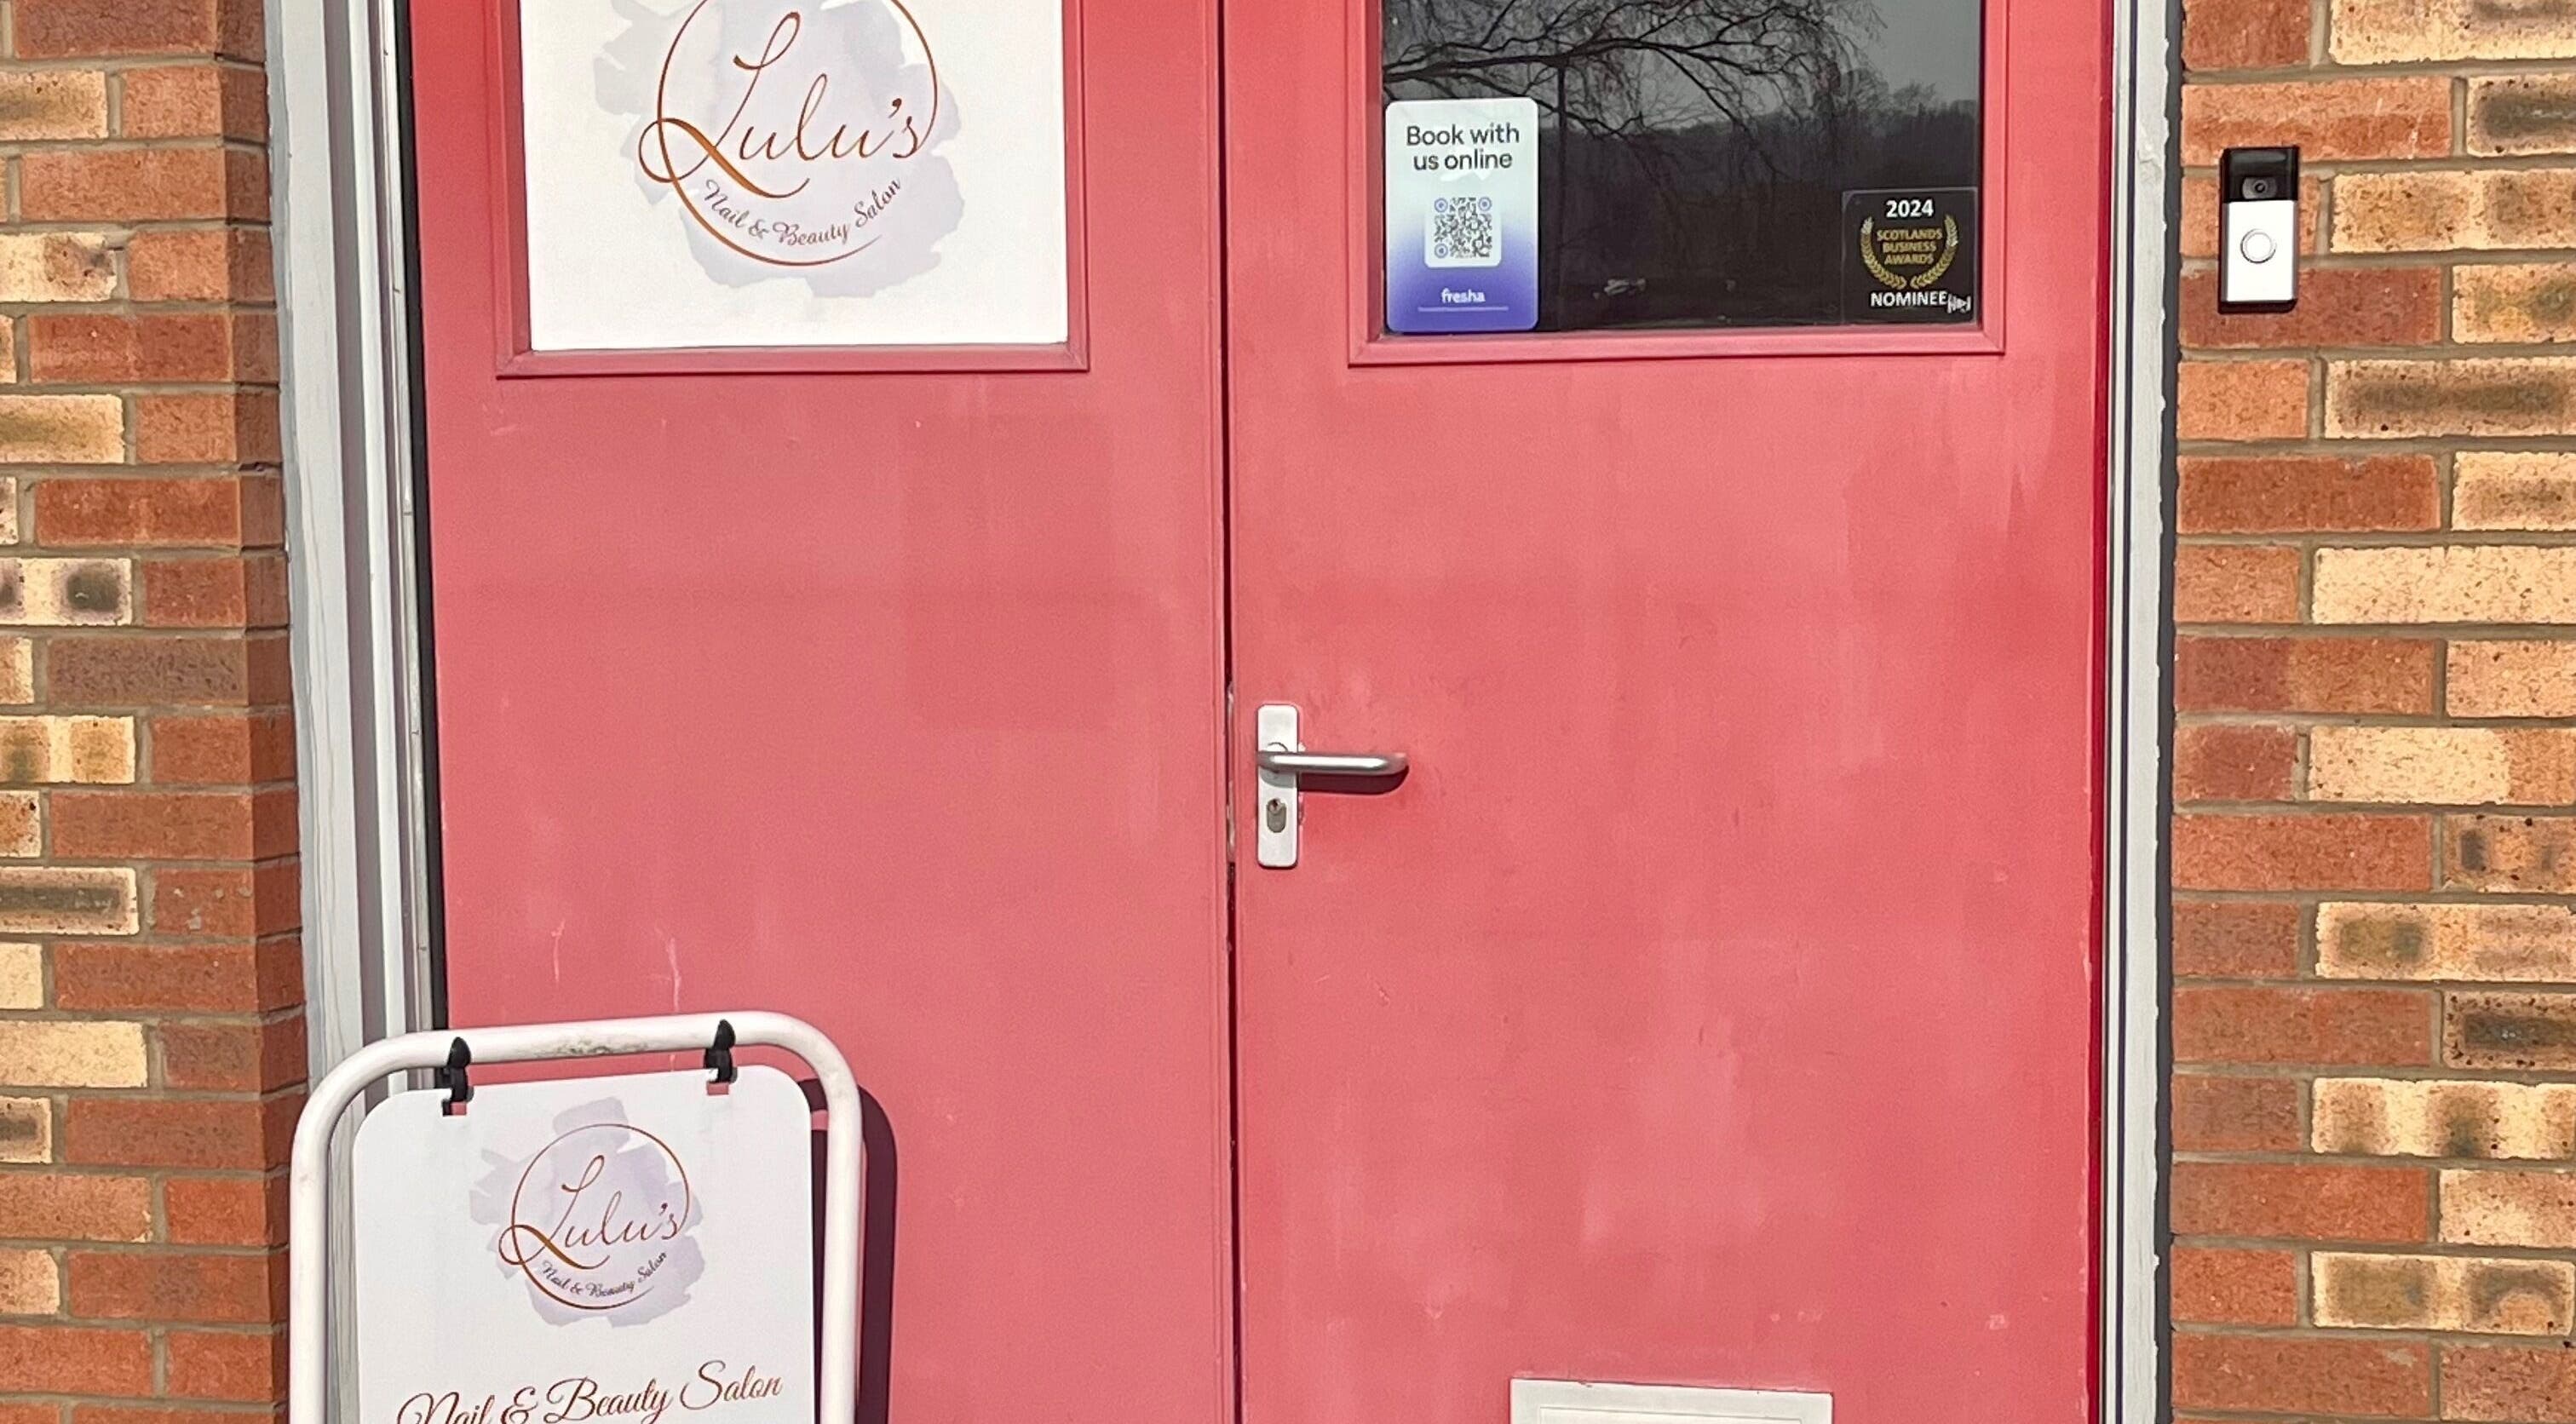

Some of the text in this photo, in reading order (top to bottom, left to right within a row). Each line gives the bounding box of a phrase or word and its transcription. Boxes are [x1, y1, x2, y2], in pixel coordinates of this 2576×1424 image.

[639, 12, 924, 198] Lulu's
[1406, 123, 1520, 146] Book with
[1413, 148, 1513, 170] us online
[704, 178, 901, 246] Nail & Beauty Salon
[1886, 199, 1934, 218] 2024
[1877, 228, 1942, 241] SCOTLANDS
[1883, 241, 1936, 253] BUSINESS
[1884, 254, 1934, 265] AWARDS
[1440, 288, 1486, 303] fresha
[1871, 290, 1948, 307] NOMINEE
[498, 1155, 681, 1269] Lulu's
[570, 1282, 583, 1295] &
[500, 1387, 540, 1424] &
[543, 1376, 674, 1424] Beauty
[680, 1359, 782, 1410] Salon
